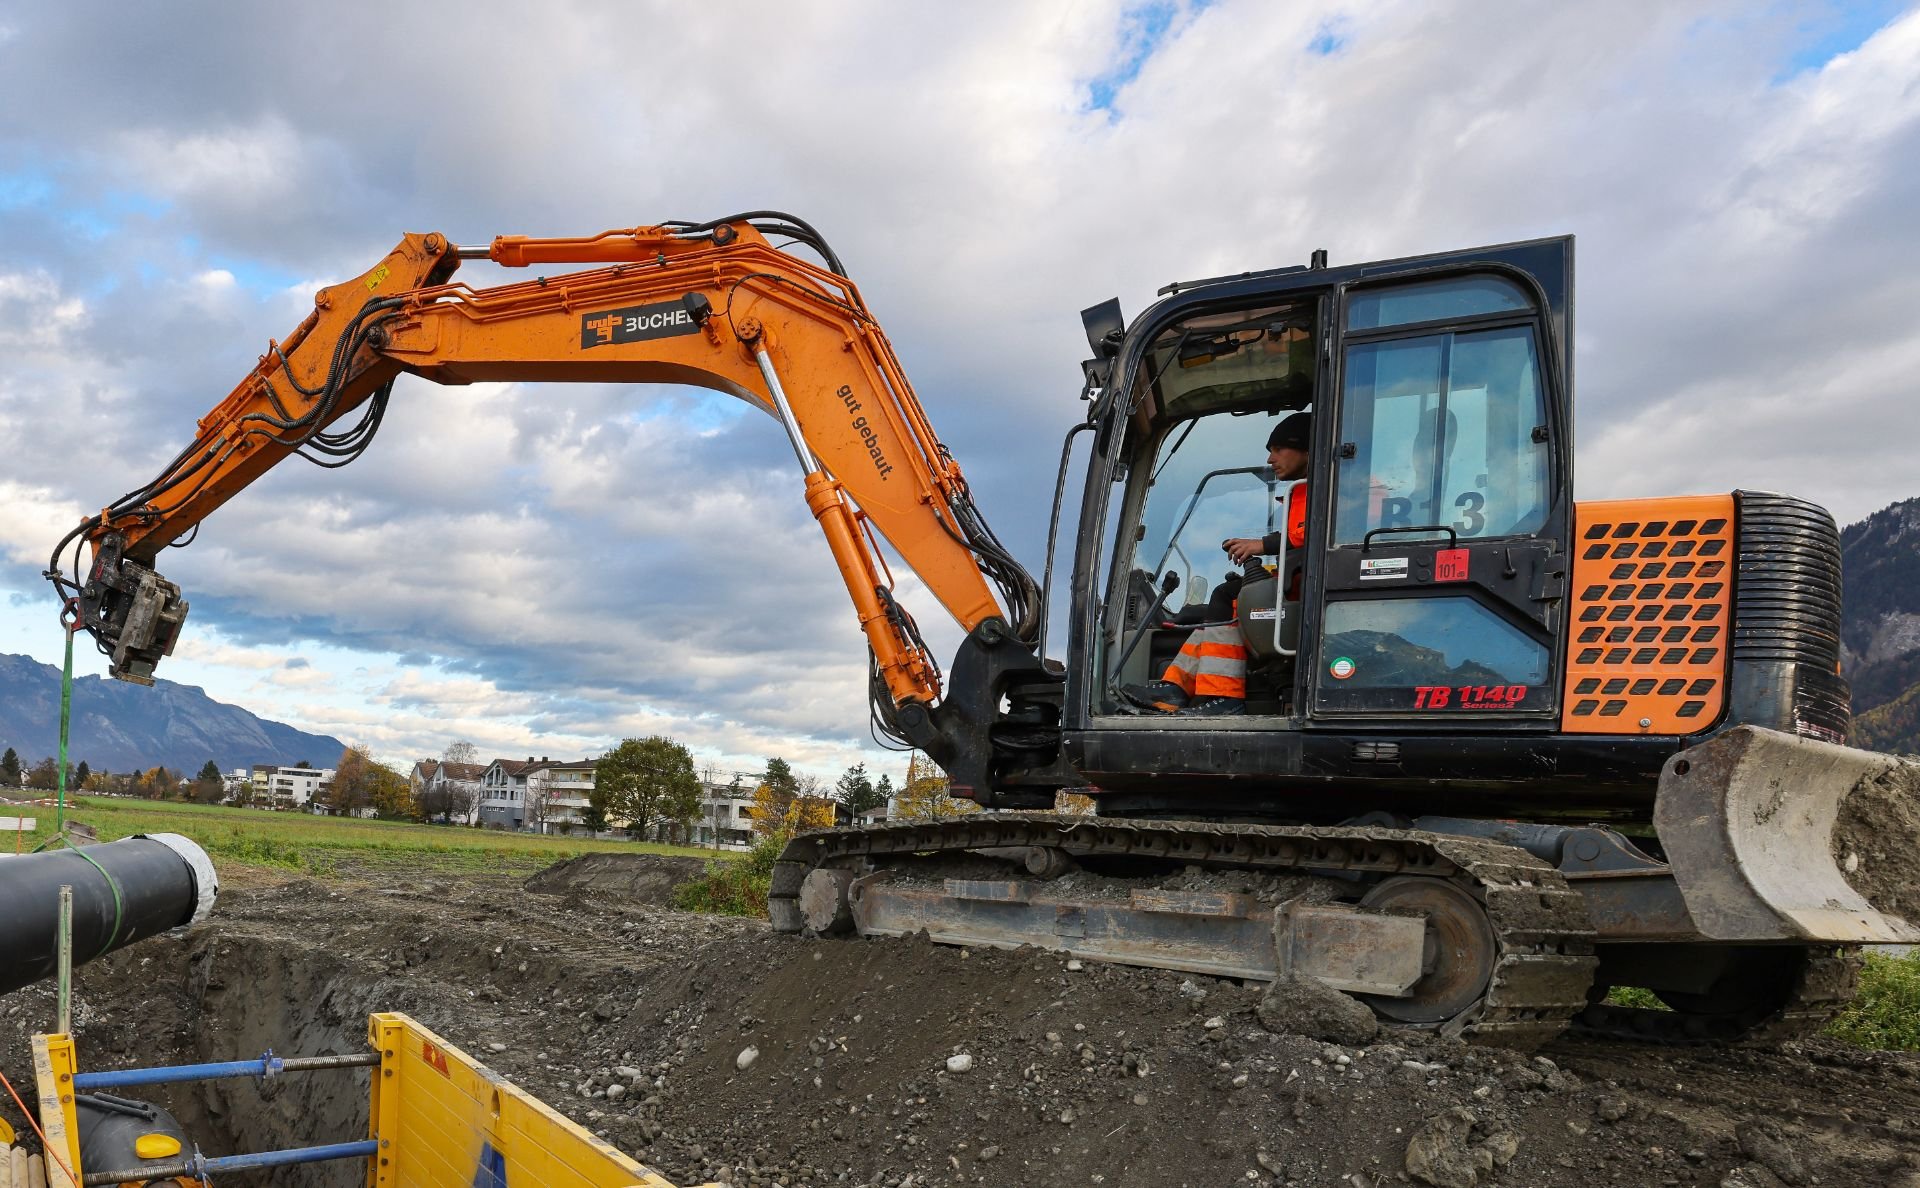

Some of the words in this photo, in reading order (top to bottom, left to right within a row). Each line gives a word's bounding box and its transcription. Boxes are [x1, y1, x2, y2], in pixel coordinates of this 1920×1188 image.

[836, 384, 862, 415] gut
[852, 416, 893, 482] gebaut.
[1439, 563, 1456, 578] 101
[1414, 686, 1452, 709] TB
[1458, 685, 1528, 702] 1140
